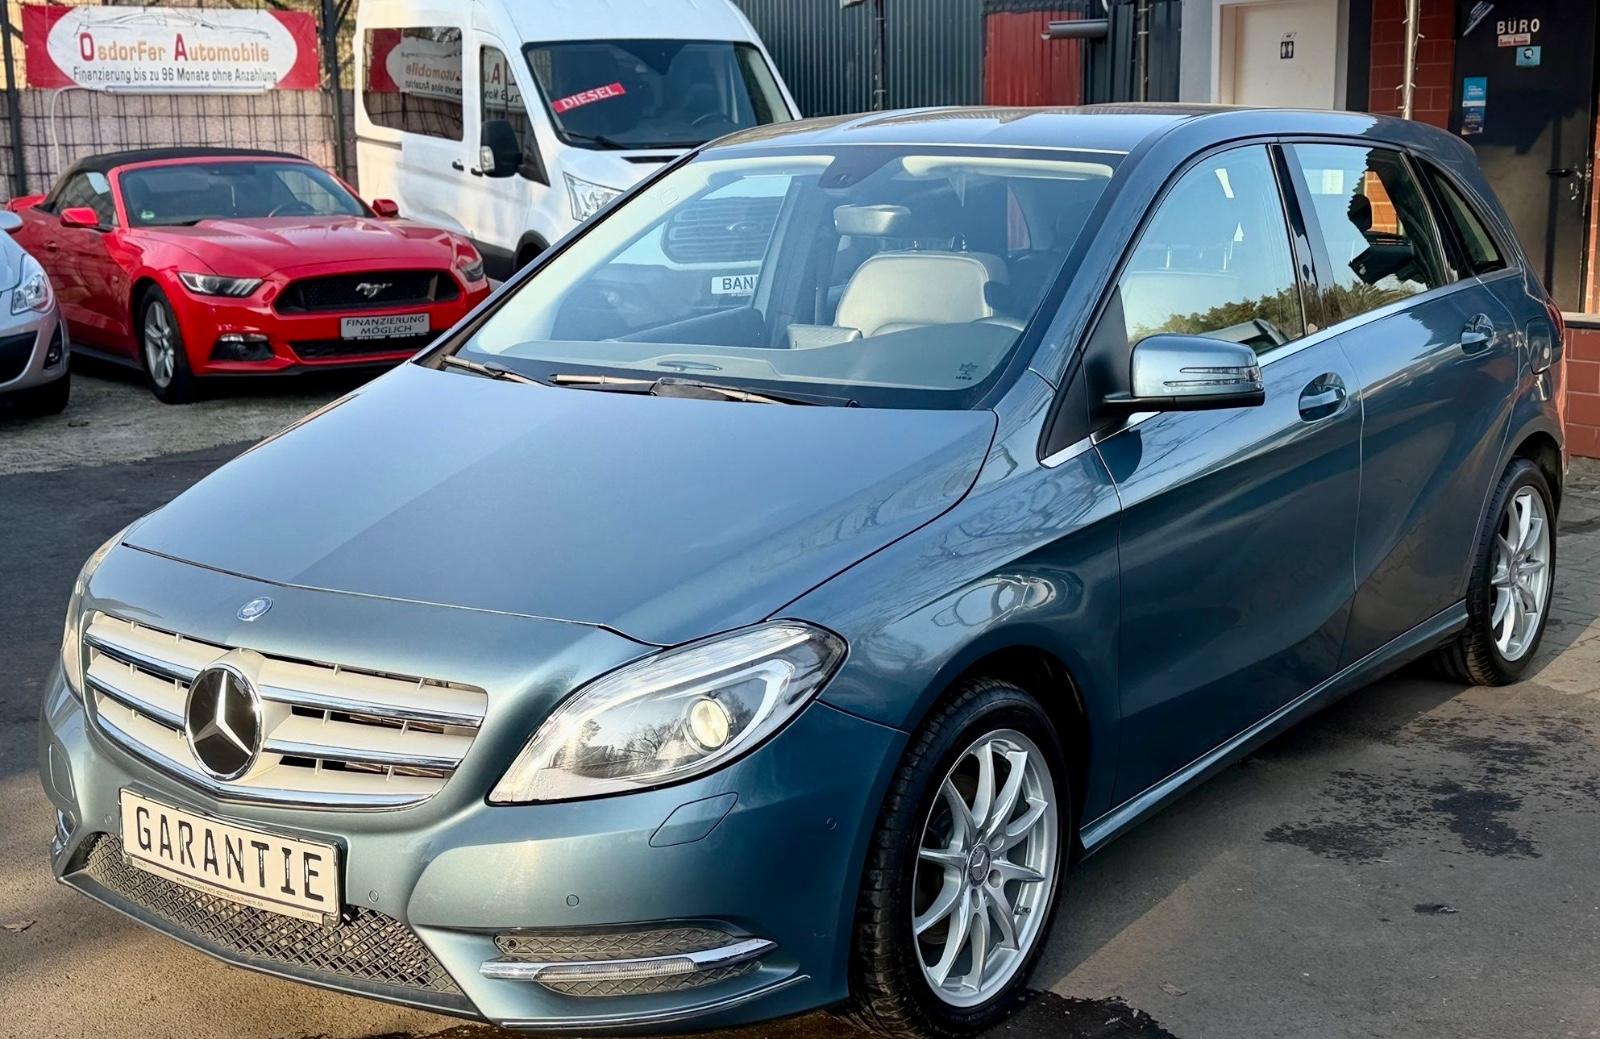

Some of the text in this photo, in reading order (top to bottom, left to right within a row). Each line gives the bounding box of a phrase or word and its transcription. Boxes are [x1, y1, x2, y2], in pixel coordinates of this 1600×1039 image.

[1496, 17, 1541, 34] BÜRO
[174, 33, 270, 61] Automobile
[73, 66, 277, 85] Finanzierung bis zu 96 Monate ohne Anzahlung
[560, 85, 620, 110] DIESEL
[721, 275, 758, 291] BAN
[346, 315, 425, 327] FINANZIERUNG
[361, 325, 412, 335] MÖGLICH
[136, 806, 324, 902] GARANTIE
